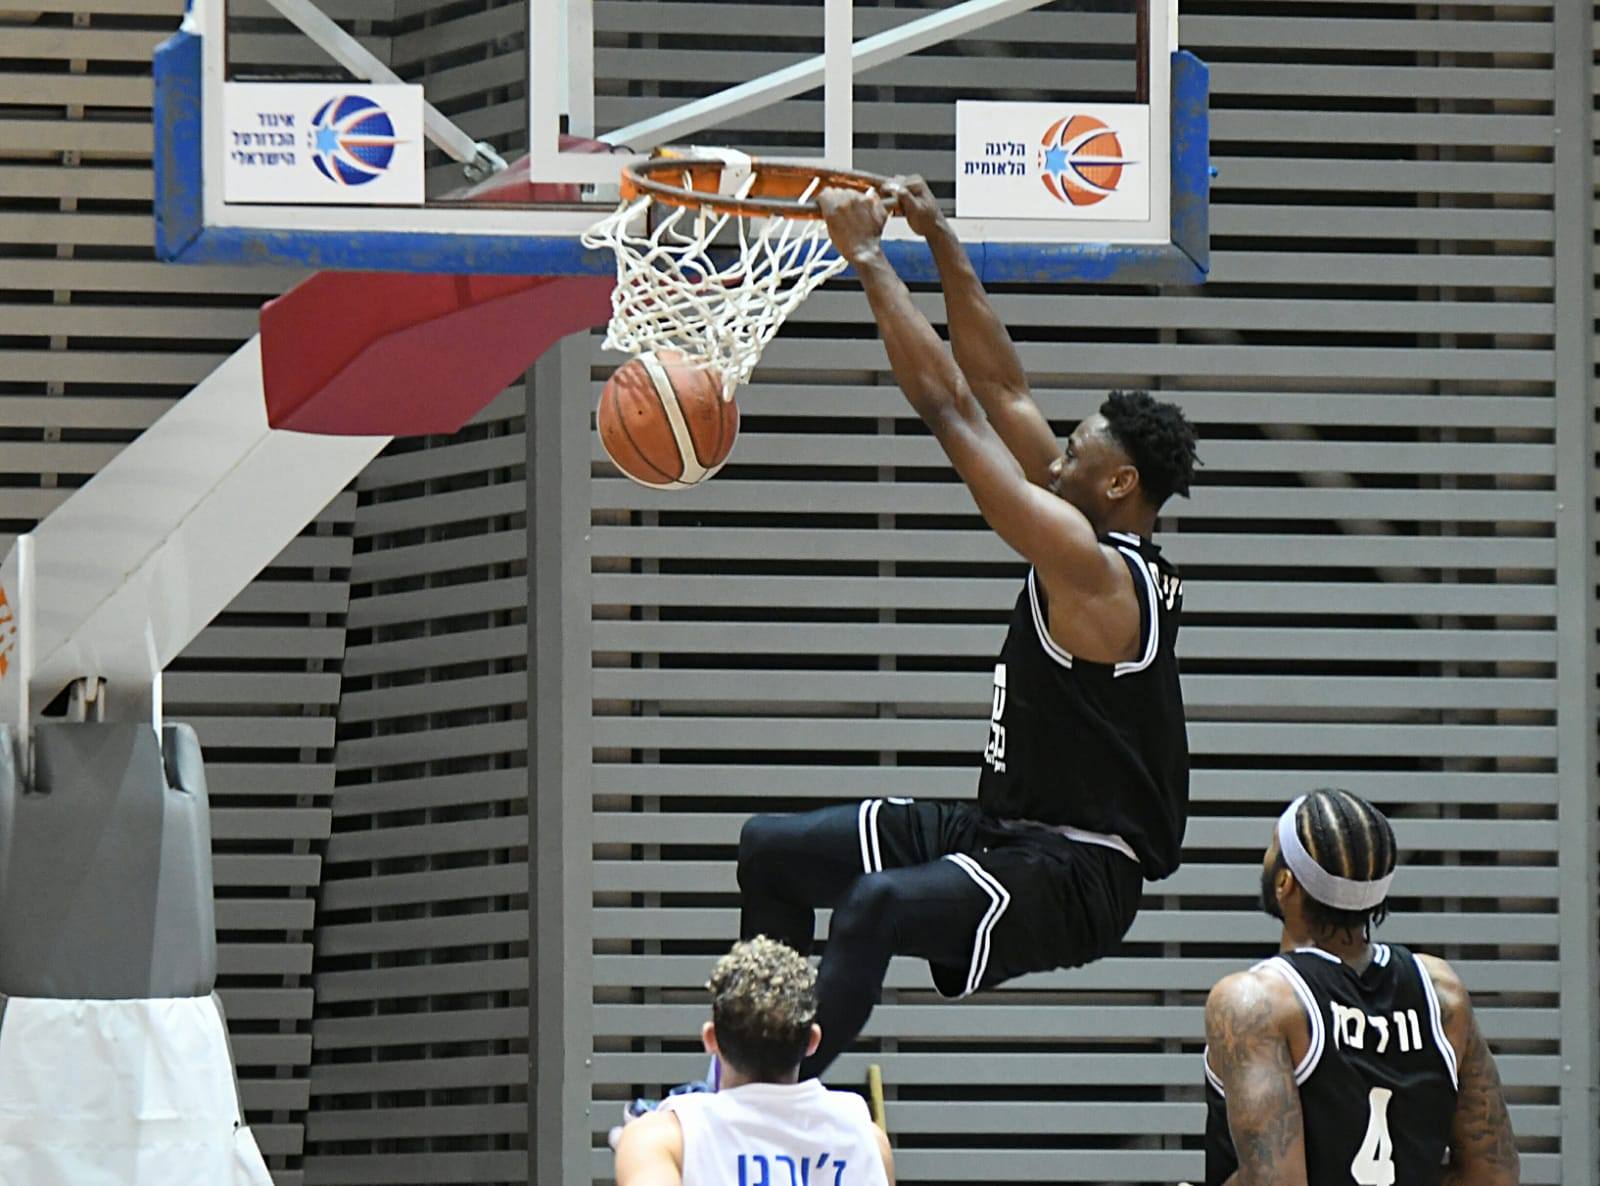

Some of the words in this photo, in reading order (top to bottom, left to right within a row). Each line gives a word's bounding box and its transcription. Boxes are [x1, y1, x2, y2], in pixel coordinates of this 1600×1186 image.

[257, 113, 295, 127] איגוד
[232, 131, 295, 147] הכדורסל
[985, 142, 1026, 156] הליגה
[231, 150, 296, 166] הישראלי
[964, 160, 1026, 175] הלאומית
[1350, 1086, 1396, 1185] 4
